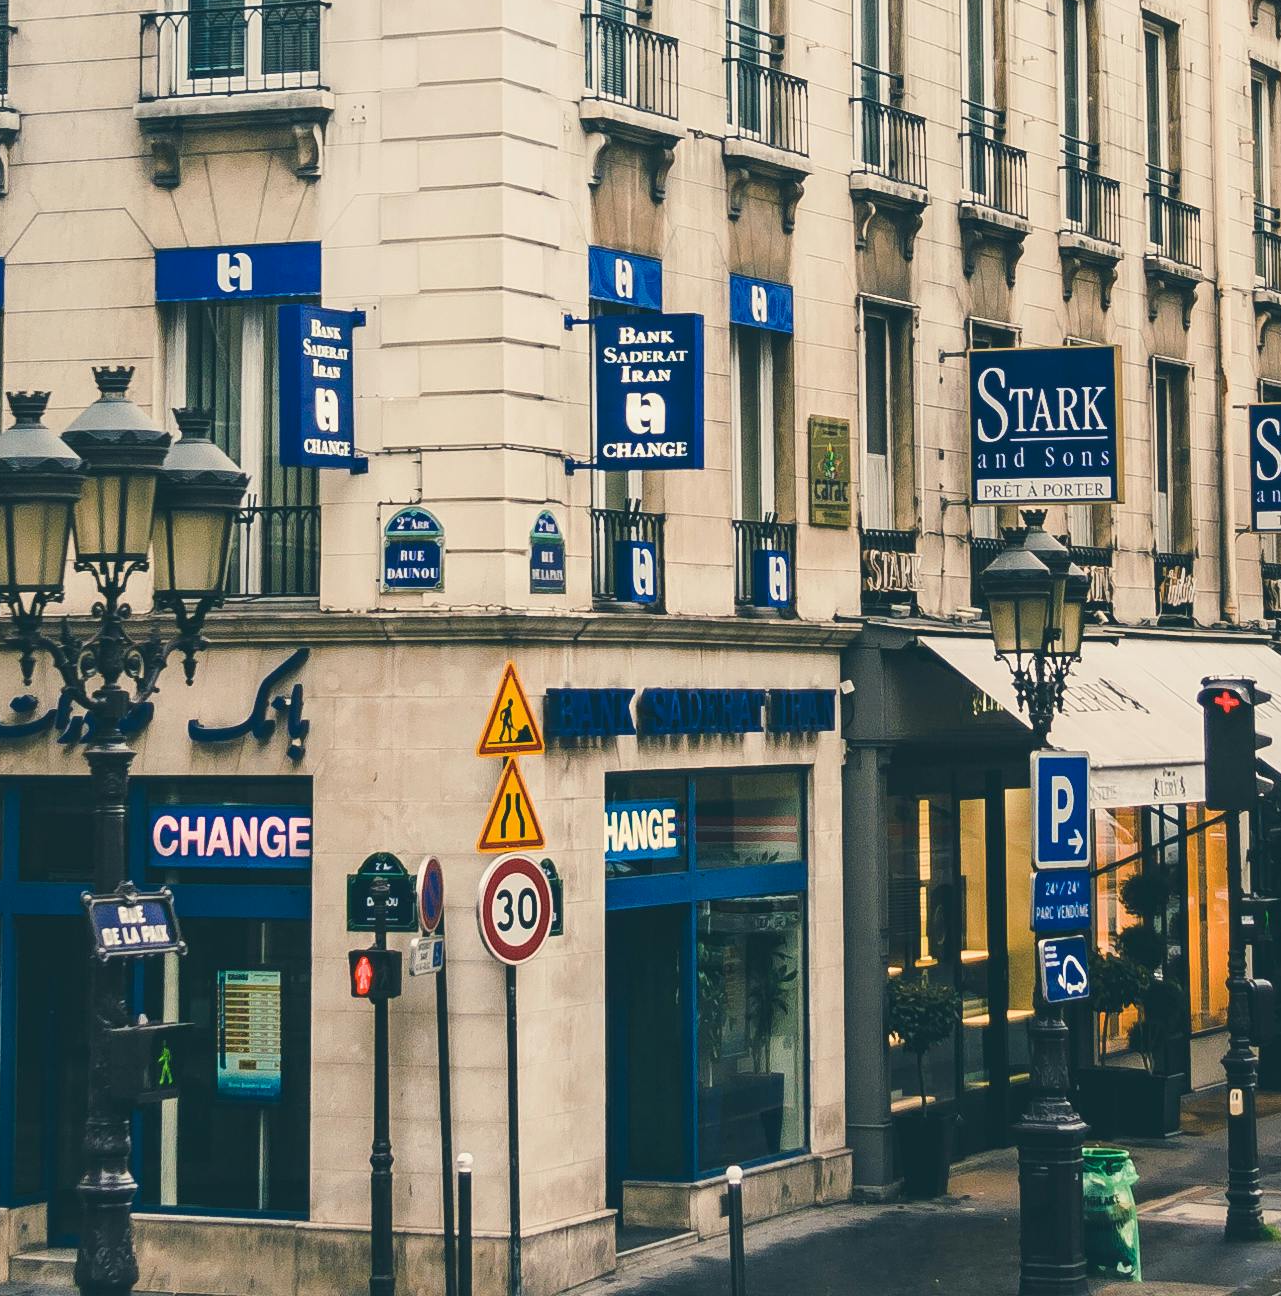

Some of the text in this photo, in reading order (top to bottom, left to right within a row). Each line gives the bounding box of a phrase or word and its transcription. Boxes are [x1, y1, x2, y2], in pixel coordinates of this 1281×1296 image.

[310, 319, 342, 340] BANK
[618, 326, 674, 344] BANK
[303, 338, 349, 360] SADERAT
[603, 347, 688, 364] SADERAT
[312, 359, 341, 378] IRAN
[620, 365, 672, 383] IRAN
[977, 367, 1108, 443] STARK
[303, 439, 351, 457] CHANGE
[602, 442, 688, 458] CHANGE
[977, 446, 1110, 469] and Sons
[984, 480, 1105, 498] PRÊT À PORTER
[400, 550, 425, 562] RUE
[386, 568, 439, 580] DAUNOU
[1051, 776, 1074, 843] P
[153, 815, 311, 857] CHANGE
[118, 905, 146, 924] RUE
[496, 888, 538, 932] 30
[1036, 901, 1089, 920] PARC VENDÔME
[101, 924, 170, 945] DE LA PAIX
